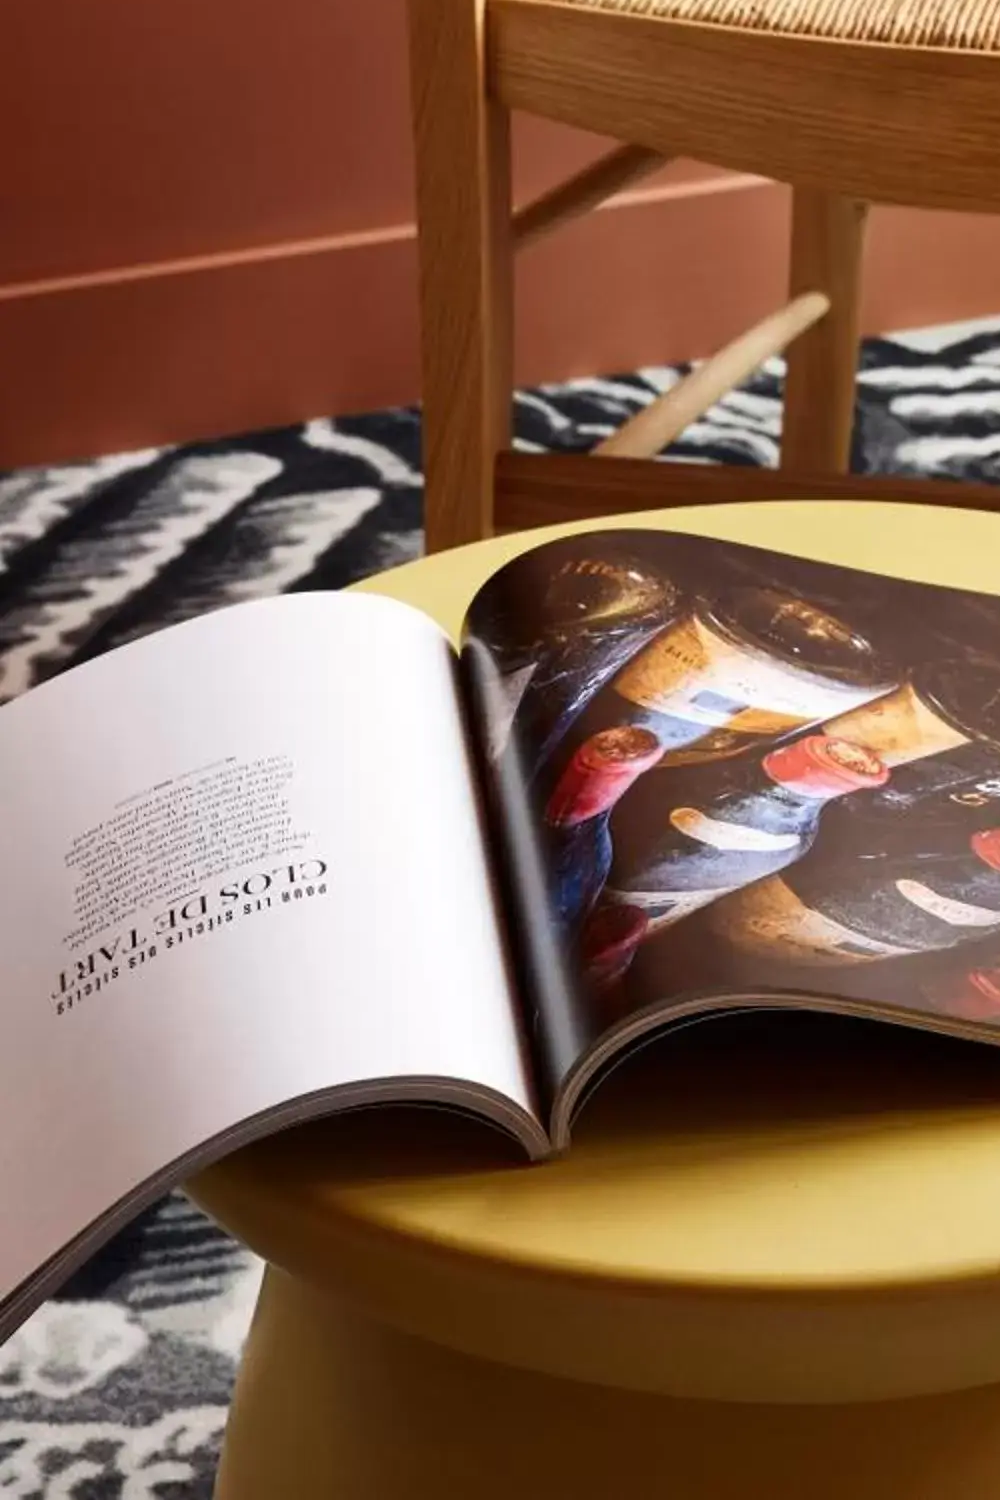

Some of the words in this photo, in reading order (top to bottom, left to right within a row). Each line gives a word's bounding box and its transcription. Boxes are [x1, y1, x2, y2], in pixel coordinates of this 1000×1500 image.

[219, 859, 328, 905] CLOS
[281, 882, 328, 902] POUR
[153, 895, 207, 935] DE
[242, 896, 273, 915] LES
[50, 928, 147, 1000] TART
[128, 945, 158, 969] DES
